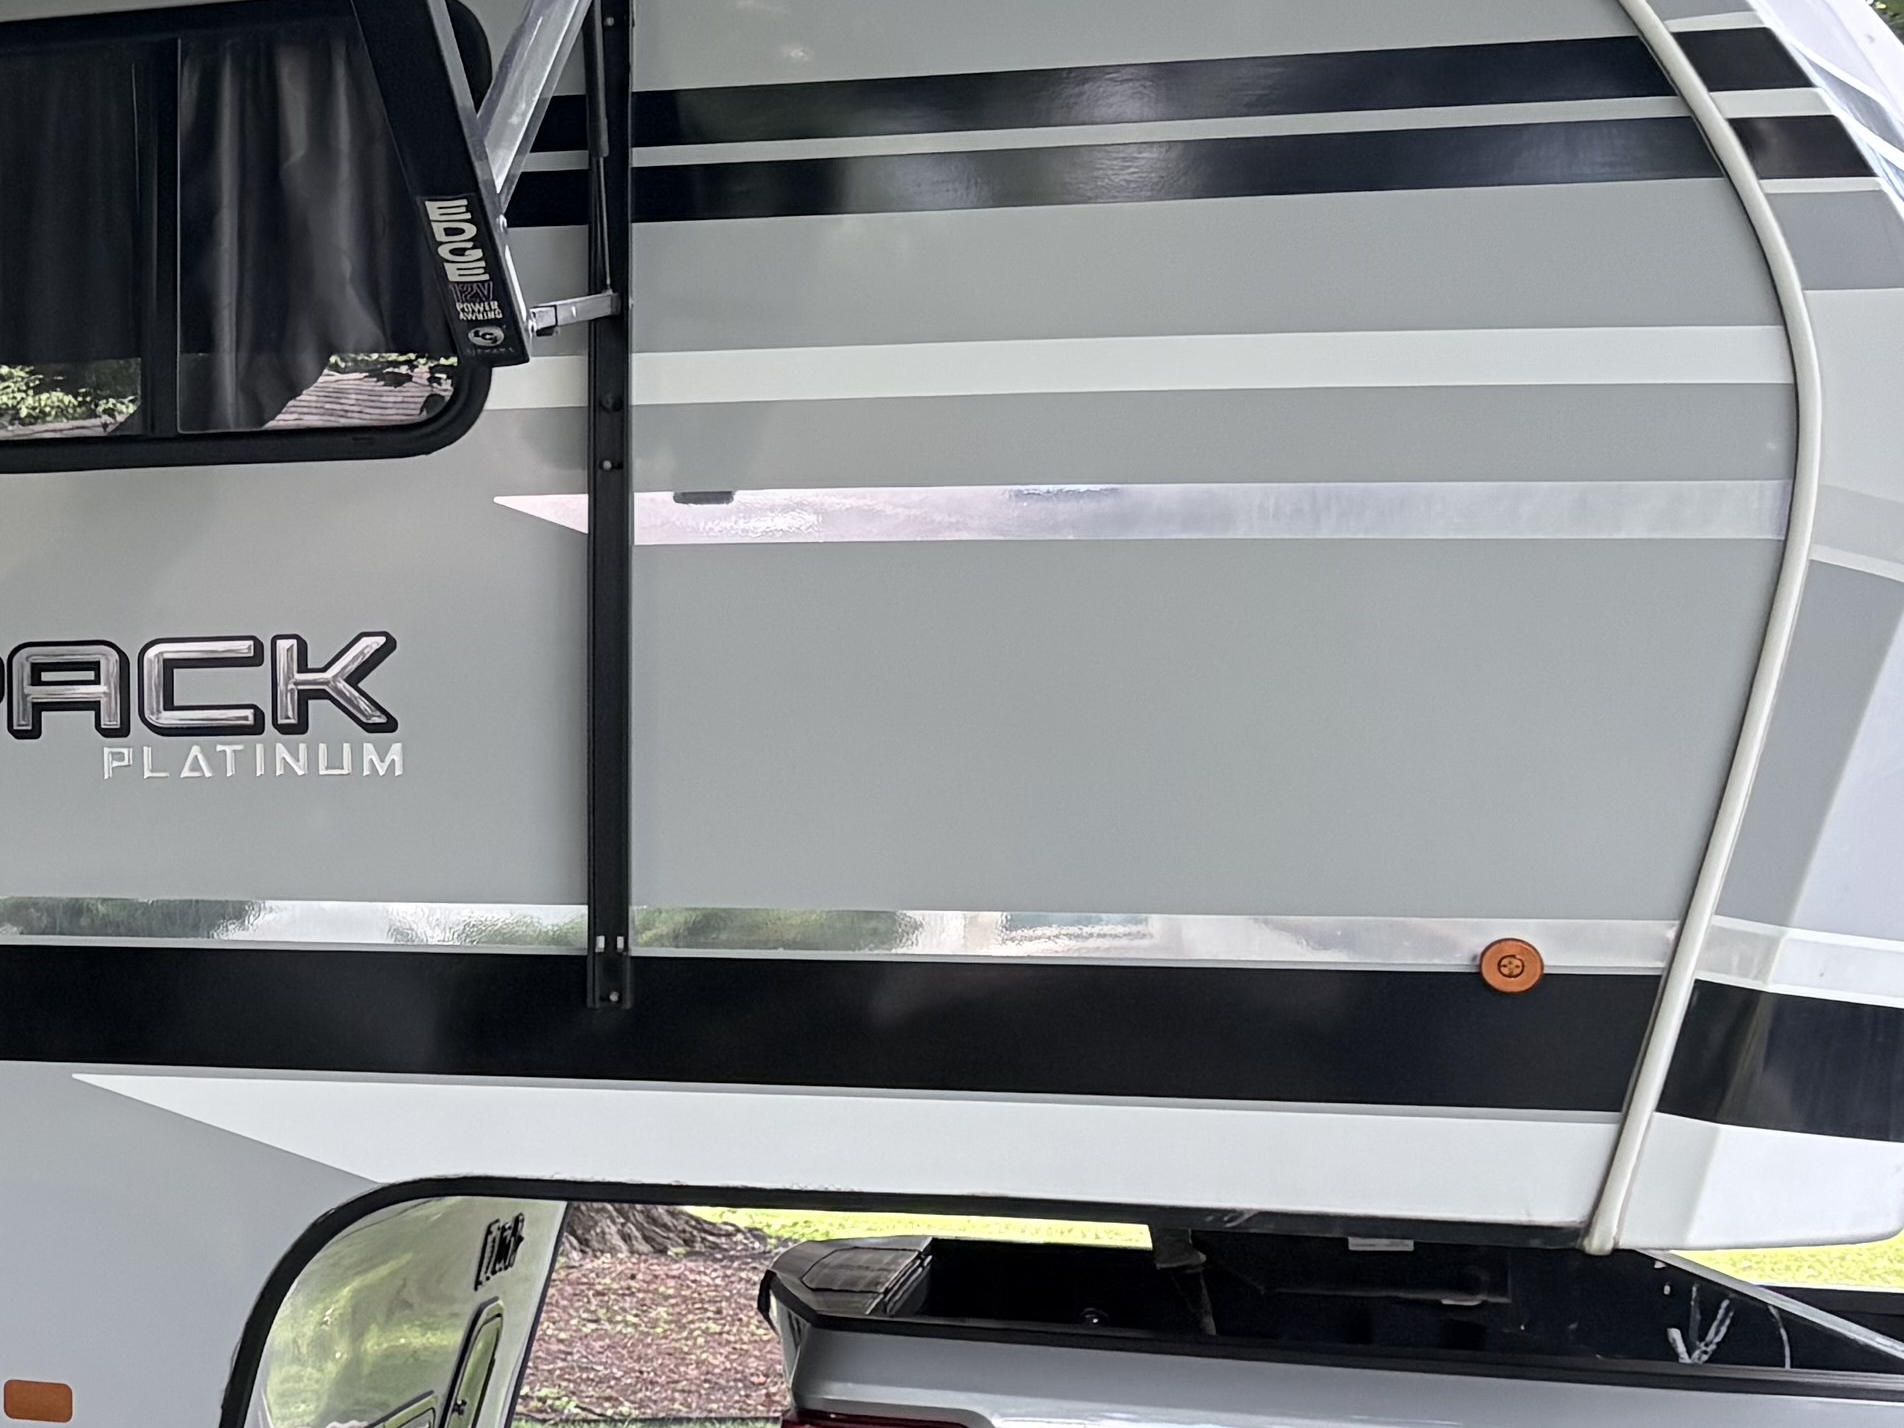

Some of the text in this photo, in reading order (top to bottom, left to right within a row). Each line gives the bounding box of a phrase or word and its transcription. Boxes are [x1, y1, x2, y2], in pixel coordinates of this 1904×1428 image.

[425, 198, 490, 282] EDGE
[455, 301, 499, 313] POWER
[459, 309, 503, 320] AWNING
[101, 740, 405, 780] PLATINUM
